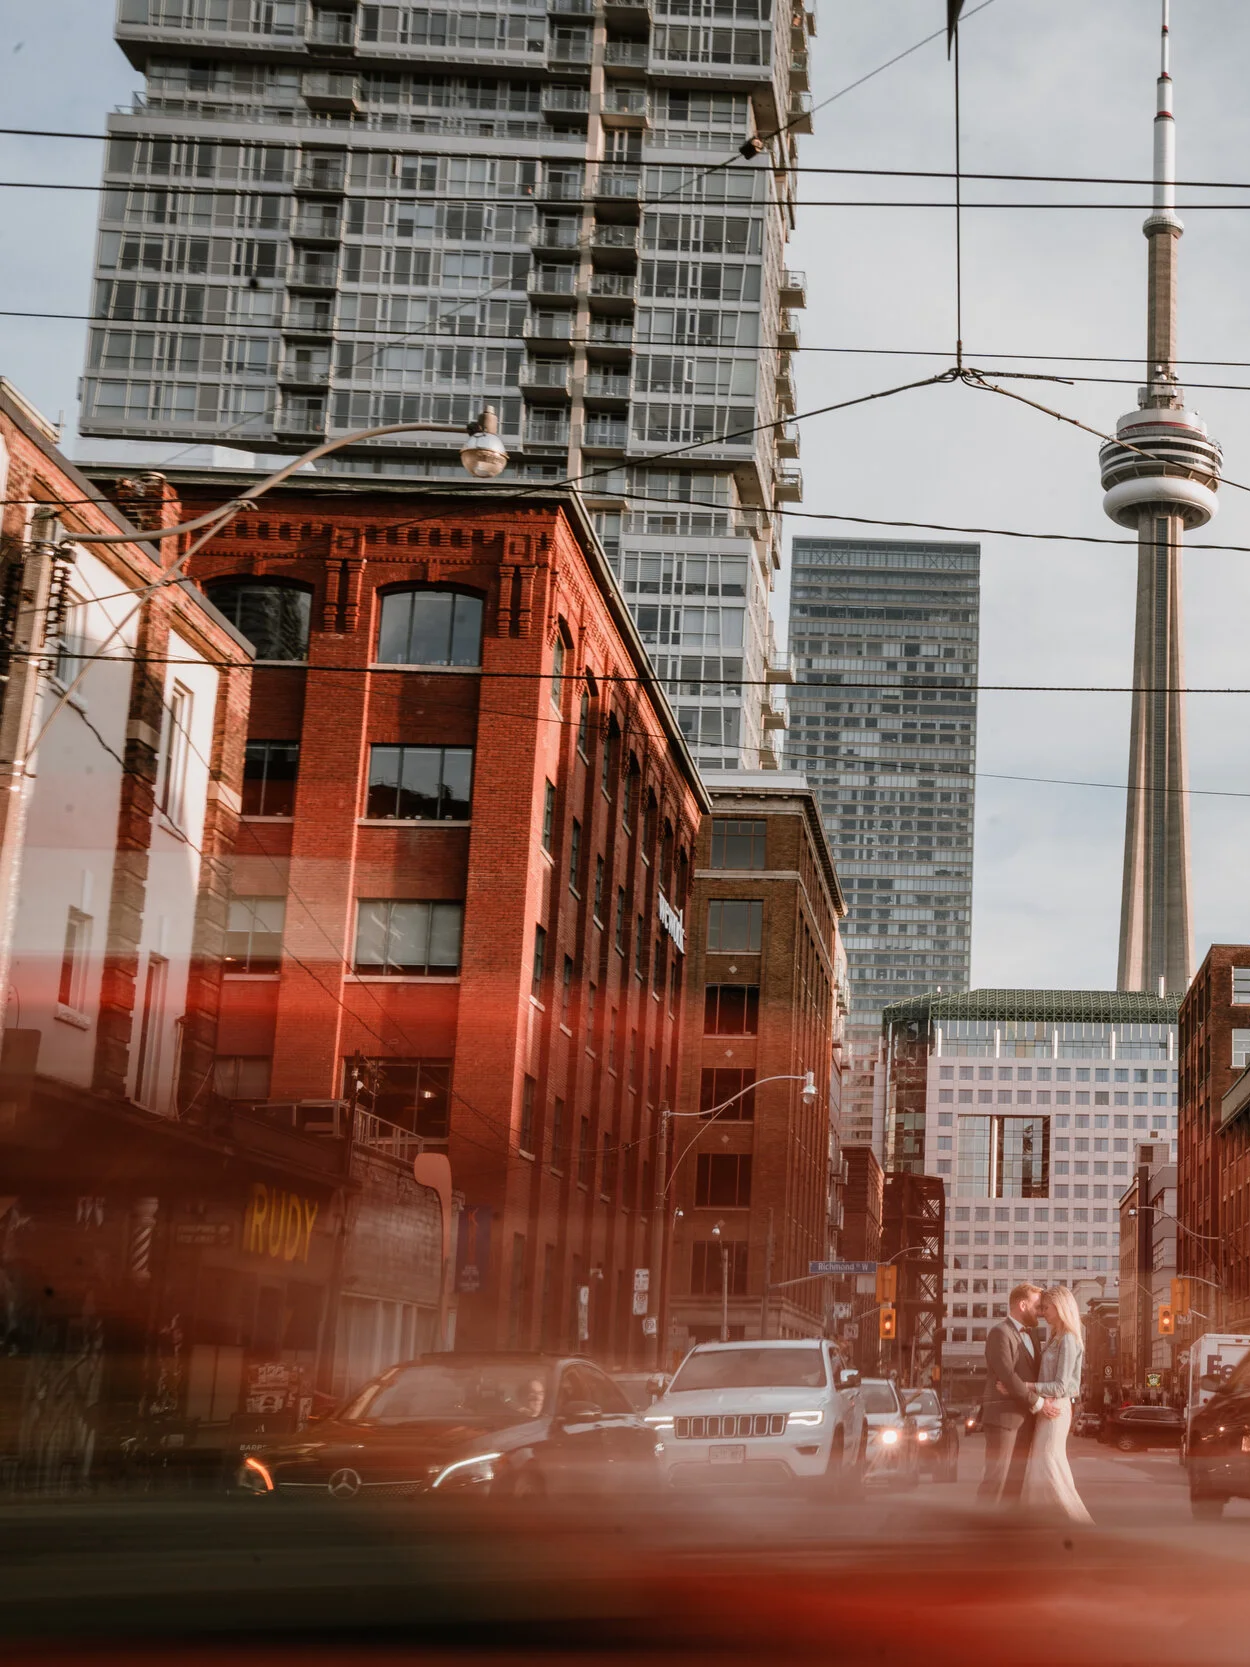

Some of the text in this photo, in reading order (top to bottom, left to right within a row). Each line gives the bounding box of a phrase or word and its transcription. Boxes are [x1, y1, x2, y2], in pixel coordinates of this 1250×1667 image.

[249, 1181, 318, 1265] RUDY
[818, 1262, 855, 1271] Richmond
[861, 1263, 869, 1271] W
